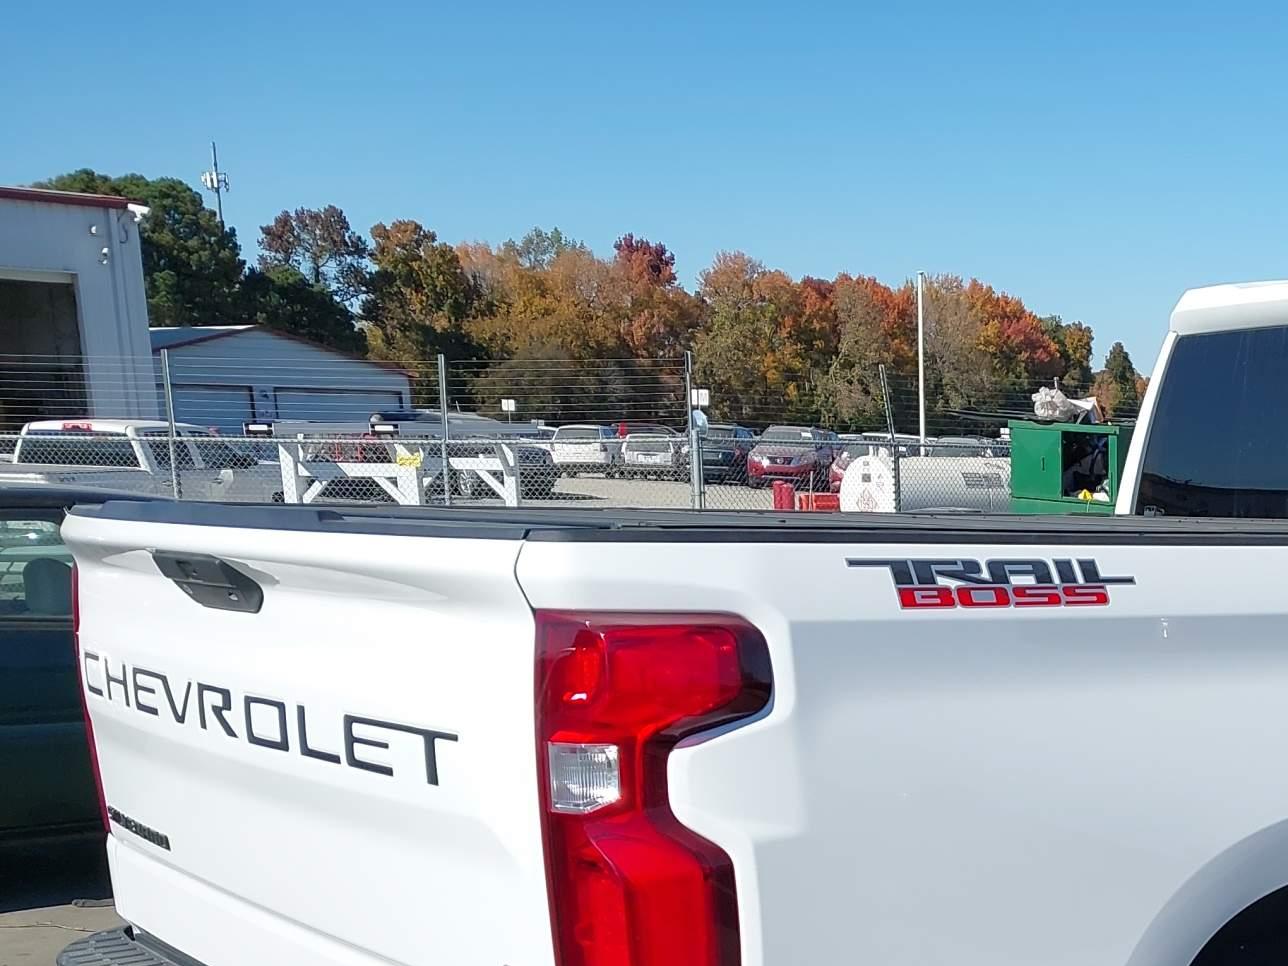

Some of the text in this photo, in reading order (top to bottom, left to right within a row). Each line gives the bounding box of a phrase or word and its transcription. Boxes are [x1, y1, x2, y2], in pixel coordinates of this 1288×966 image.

[845, 558, 1136, 586] TRAIL
[897, 586, 1111, 609] BOSS
[83, 651, 459, 786] CHEVROLET
